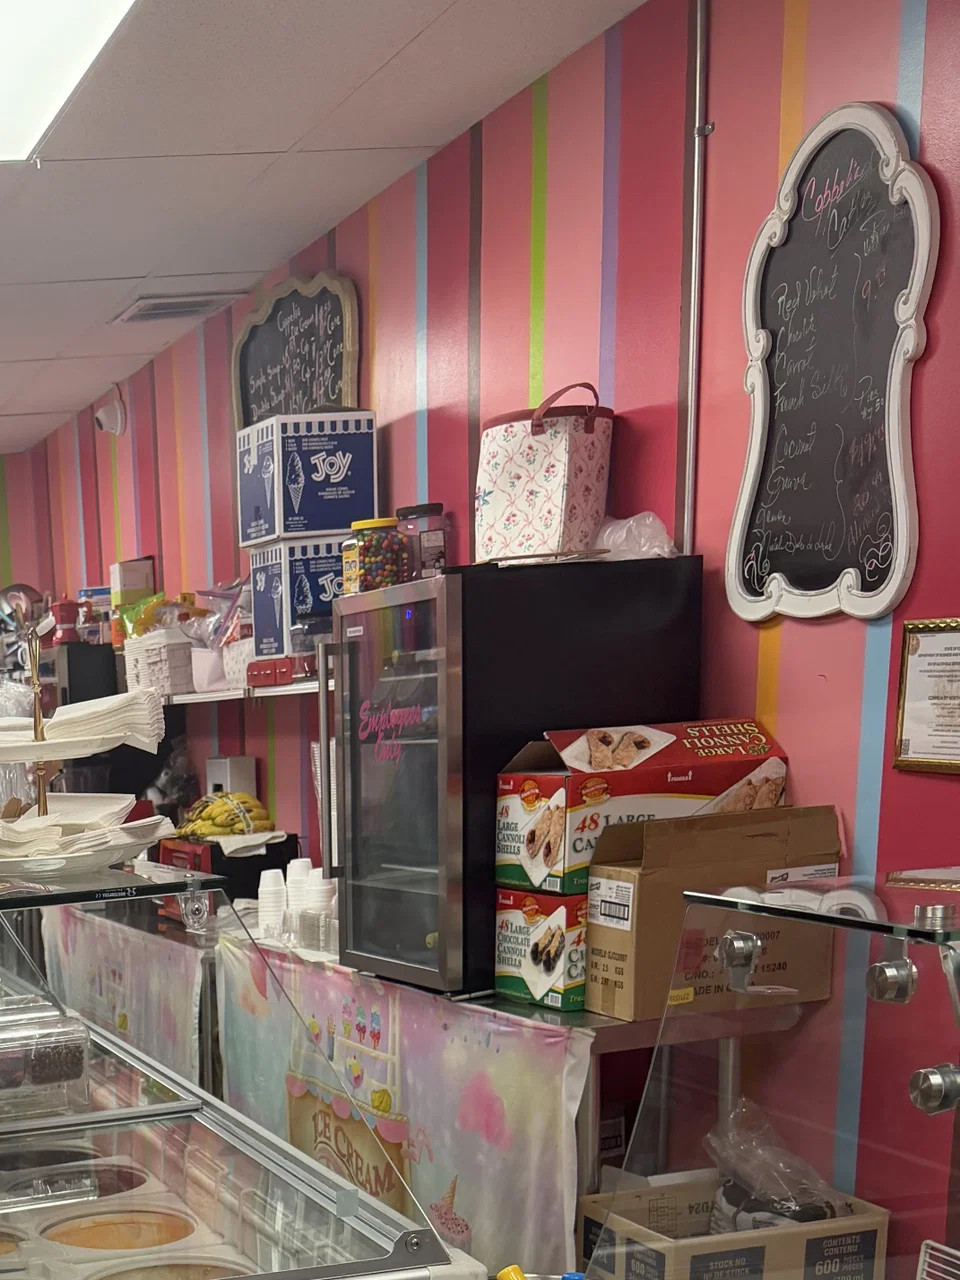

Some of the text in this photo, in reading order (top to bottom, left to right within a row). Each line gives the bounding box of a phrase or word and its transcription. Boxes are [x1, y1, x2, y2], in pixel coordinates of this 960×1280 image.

[329, 373, 343, 399] Con
[318, 573, 344, 602] Jo
[687, 722, 759, 737] SHELLS
[682, 733, 767, 749] CANNOLI
[695, 744, 771, 757] 48 LARGE
[497, 805, 509, 819] 48
[497, 820, 519, 832] LARGE
[574, 812, 600, 834] 48
[497, 832, 525, 845] CANNOLI
[497, 843, 521, 855] SHELLS
[498, 919, 531, 937] 48 LARGE
[497, 932, 531, 947] CHOCOLATE
[570, 930, 587, 948] 4
[497, 943, 527, 957] CANNOLI
[497, 953, 522, 968] SHELLS
[692, 986, 712, 997] ADE
[714, 985, 725, 995] IN
[312, 1109, 396, 1198] ICE CREAM
[822, 1235, 861, 1249] CONTENTS
[824, 1245, 858, 1257] CONTENU
[709, 1258, 734, 1269] STOCK
[815, 1258, 840, 1276] 600
[726, 1267, 751, 1279] STOCK
